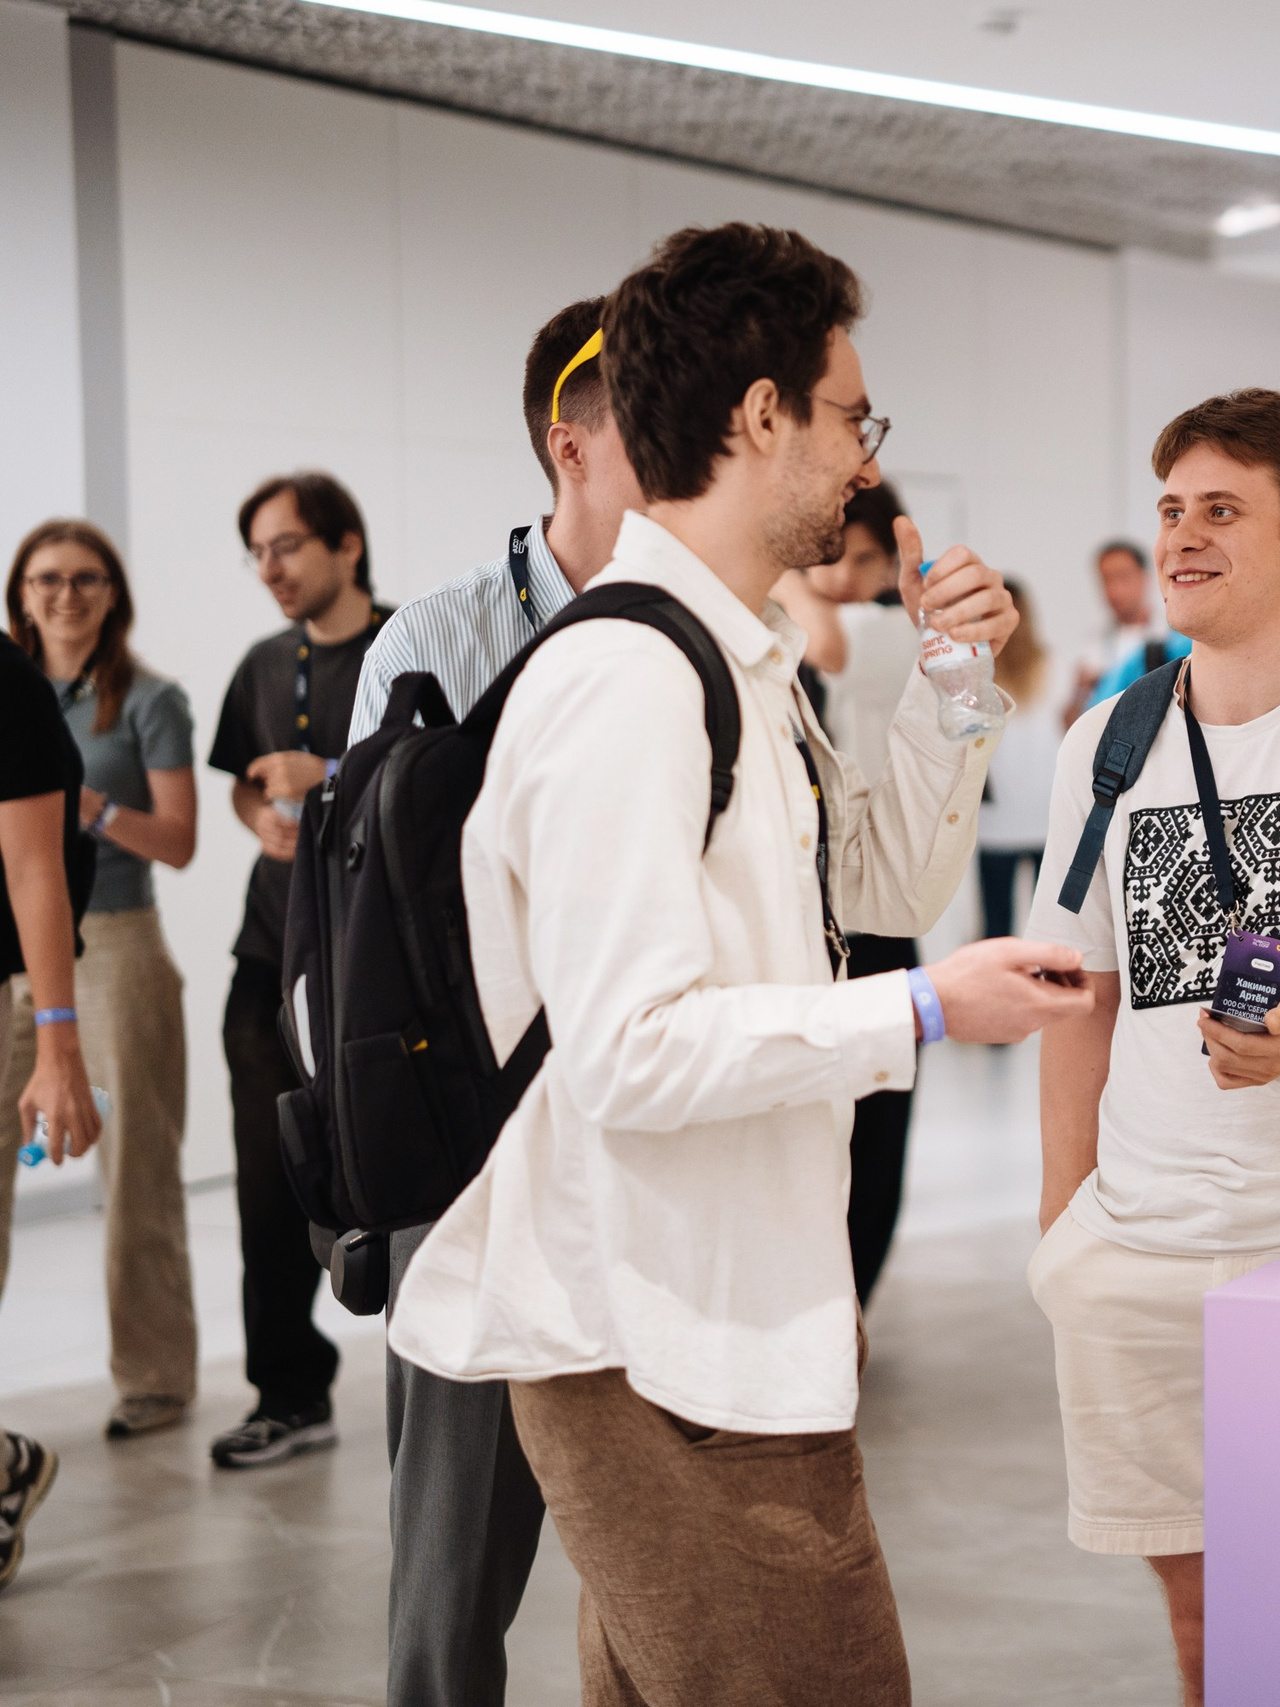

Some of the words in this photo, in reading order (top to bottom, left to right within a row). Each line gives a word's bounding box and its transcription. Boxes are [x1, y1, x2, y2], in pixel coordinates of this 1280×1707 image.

[1236, 977, 1277, 995] Хакимов
[1222, 998, 1237, 1008] ООО
[1239, 990, 1269, 1005] Артём
